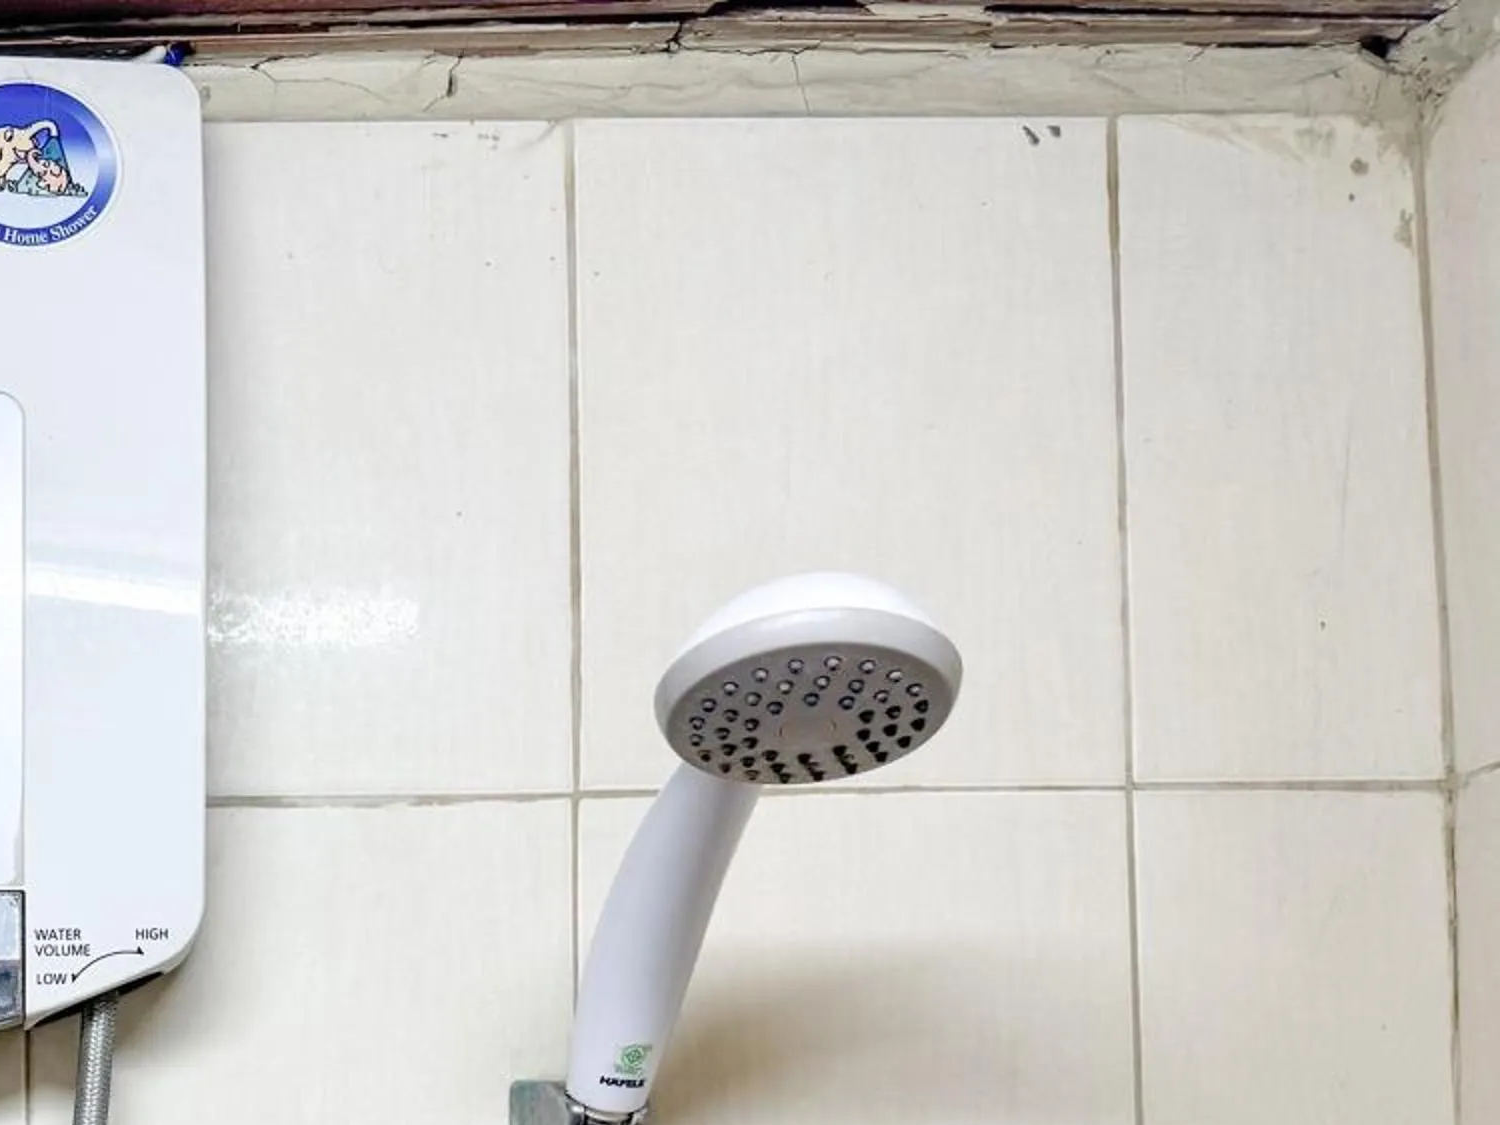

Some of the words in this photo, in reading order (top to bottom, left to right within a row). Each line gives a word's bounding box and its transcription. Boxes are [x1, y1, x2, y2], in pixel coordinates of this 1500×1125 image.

[3, 228, 49, 246] Home
[50, 204, 99, 241] Shower
[34, 928, 82, 941] WATER
[135, 928, 169, 940] HIGH
[34, 944, 91, 957] VOLUME
[36, 973, 67, 985] LOW
